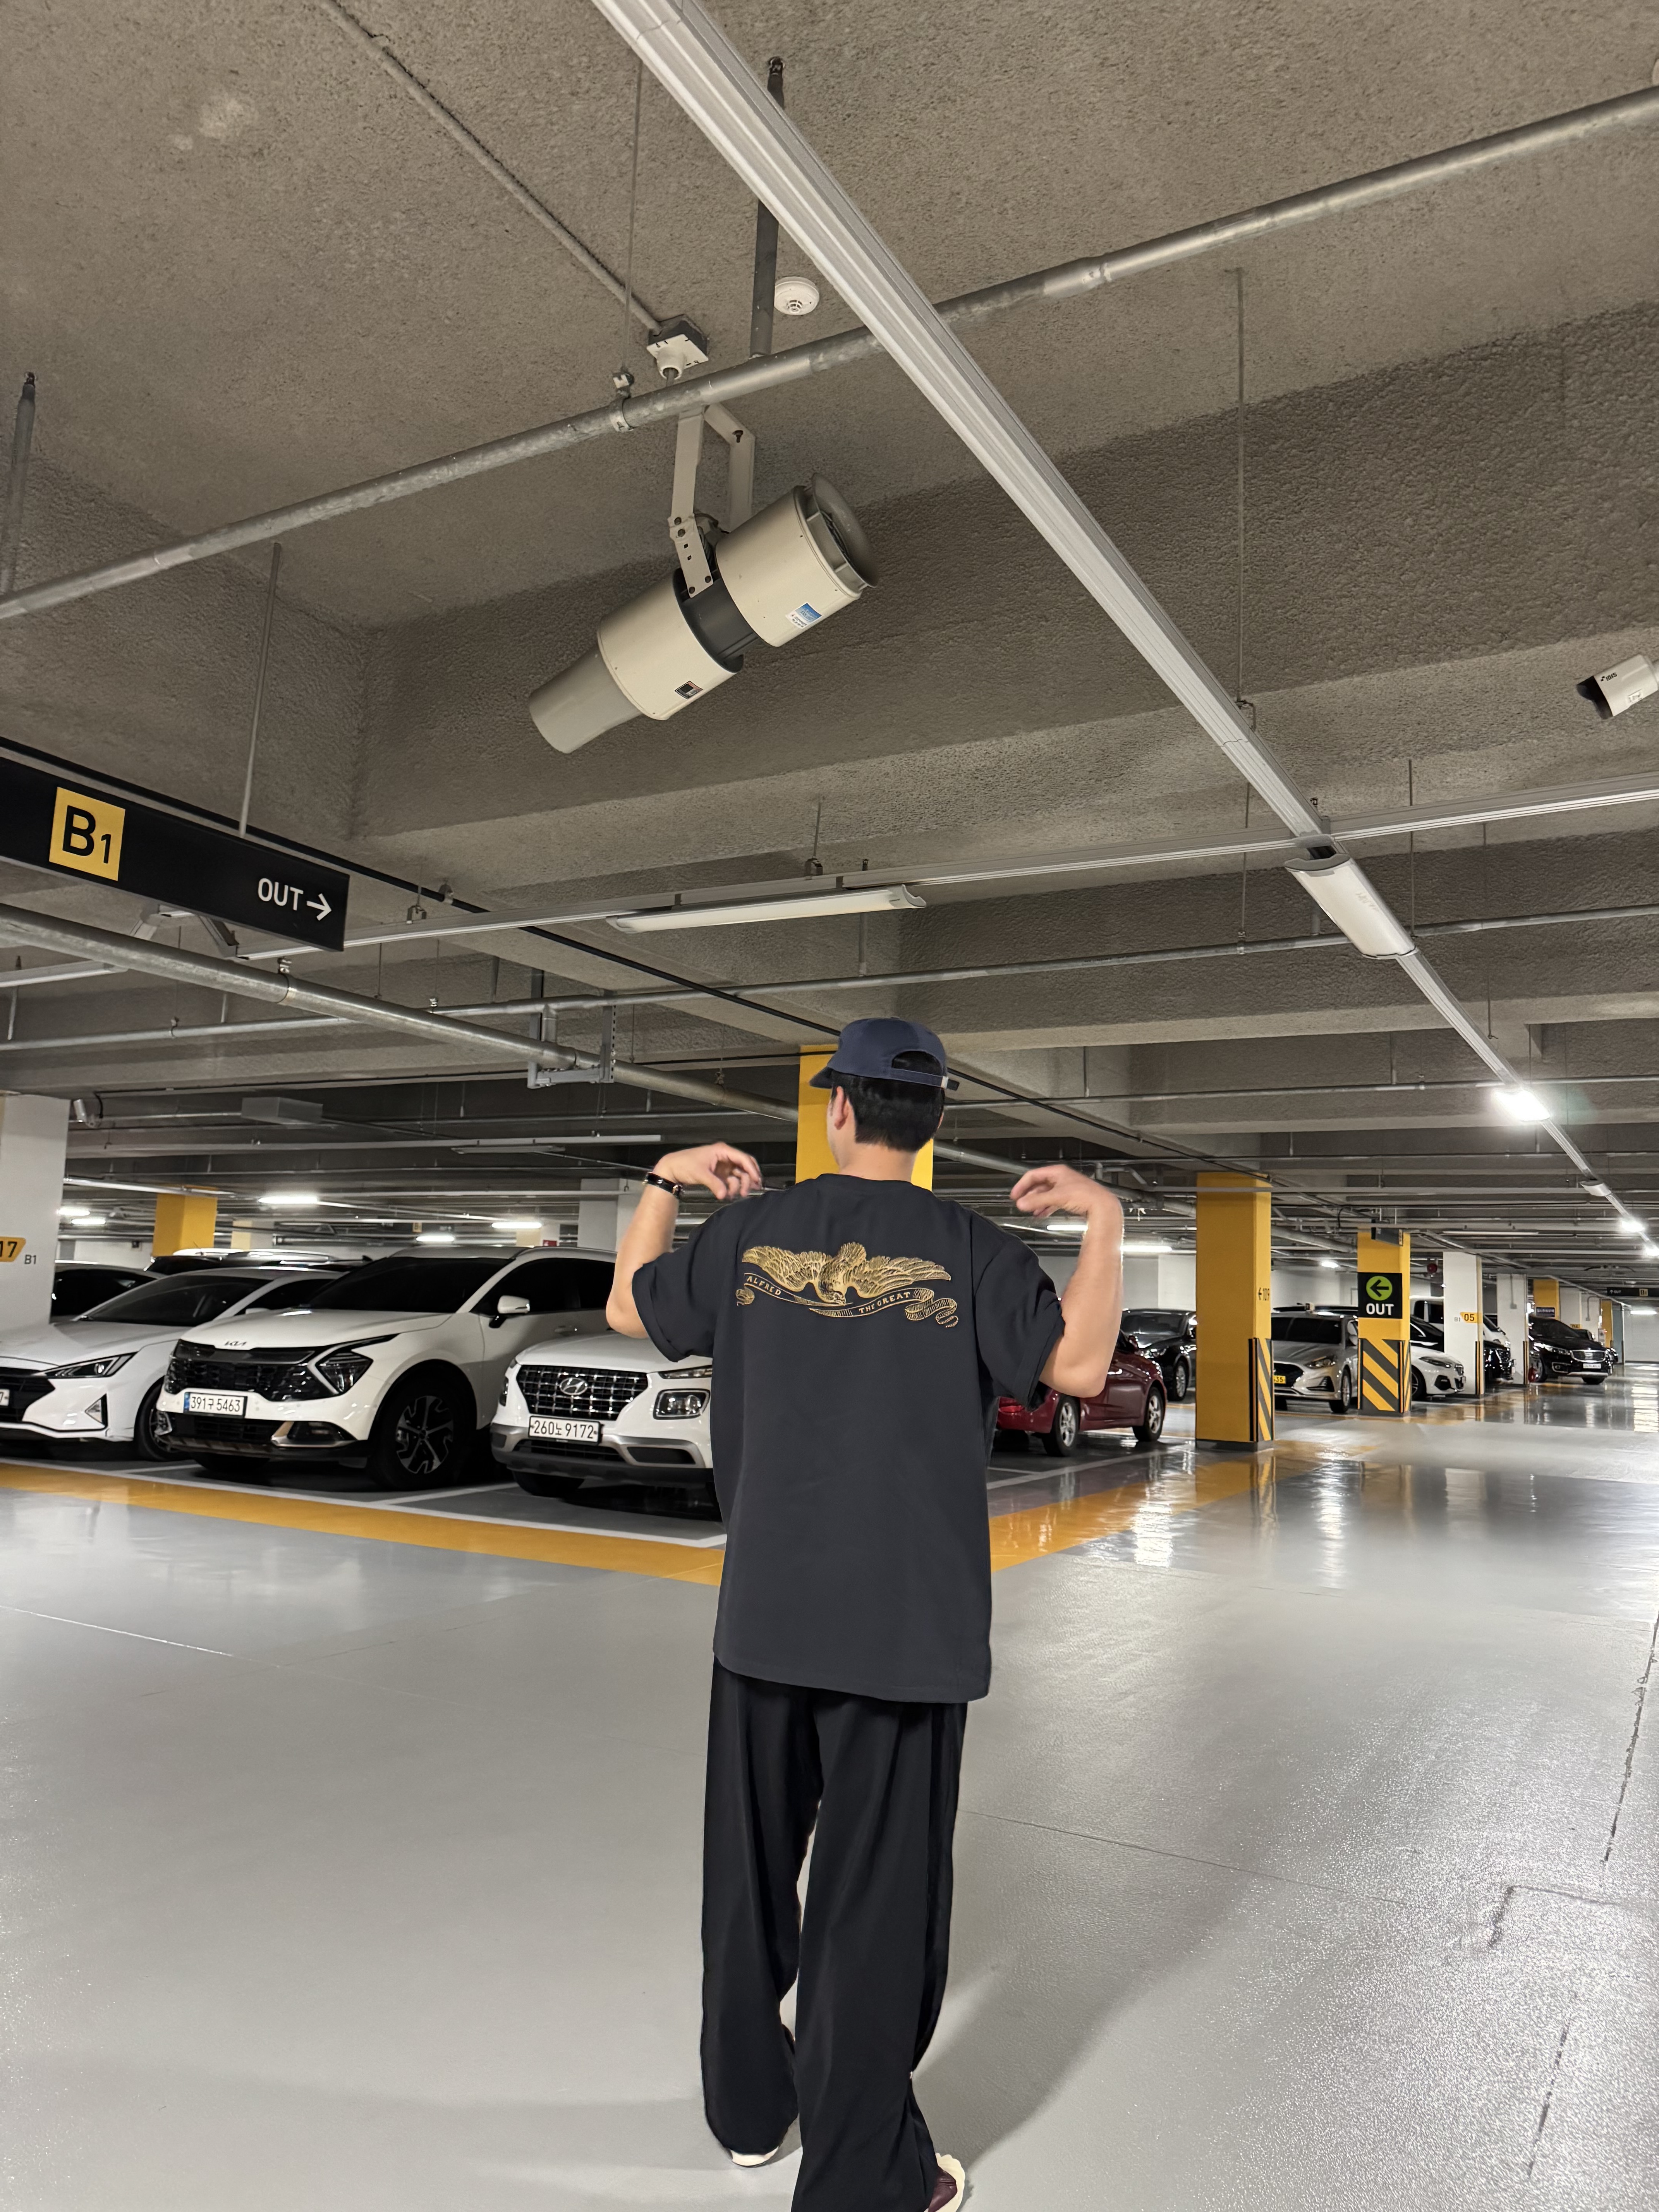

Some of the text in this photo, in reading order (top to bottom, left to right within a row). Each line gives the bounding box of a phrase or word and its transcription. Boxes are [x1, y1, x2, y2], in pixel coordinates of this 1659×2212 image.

[62, 805, 111, 864] B1
[258, 878, 304, 910] OUT
[24, 1254, 36, 1264] B1
[747, 1276, 781, 1295] ALFRED
[859, 1291, 910, 1314] THE GREAT
[1366, 1303, 1394, 1316] OUT
[191, 1396, 240, 1412] 391구 5463
[534, 1420, 594, 1439] 260노 9172
